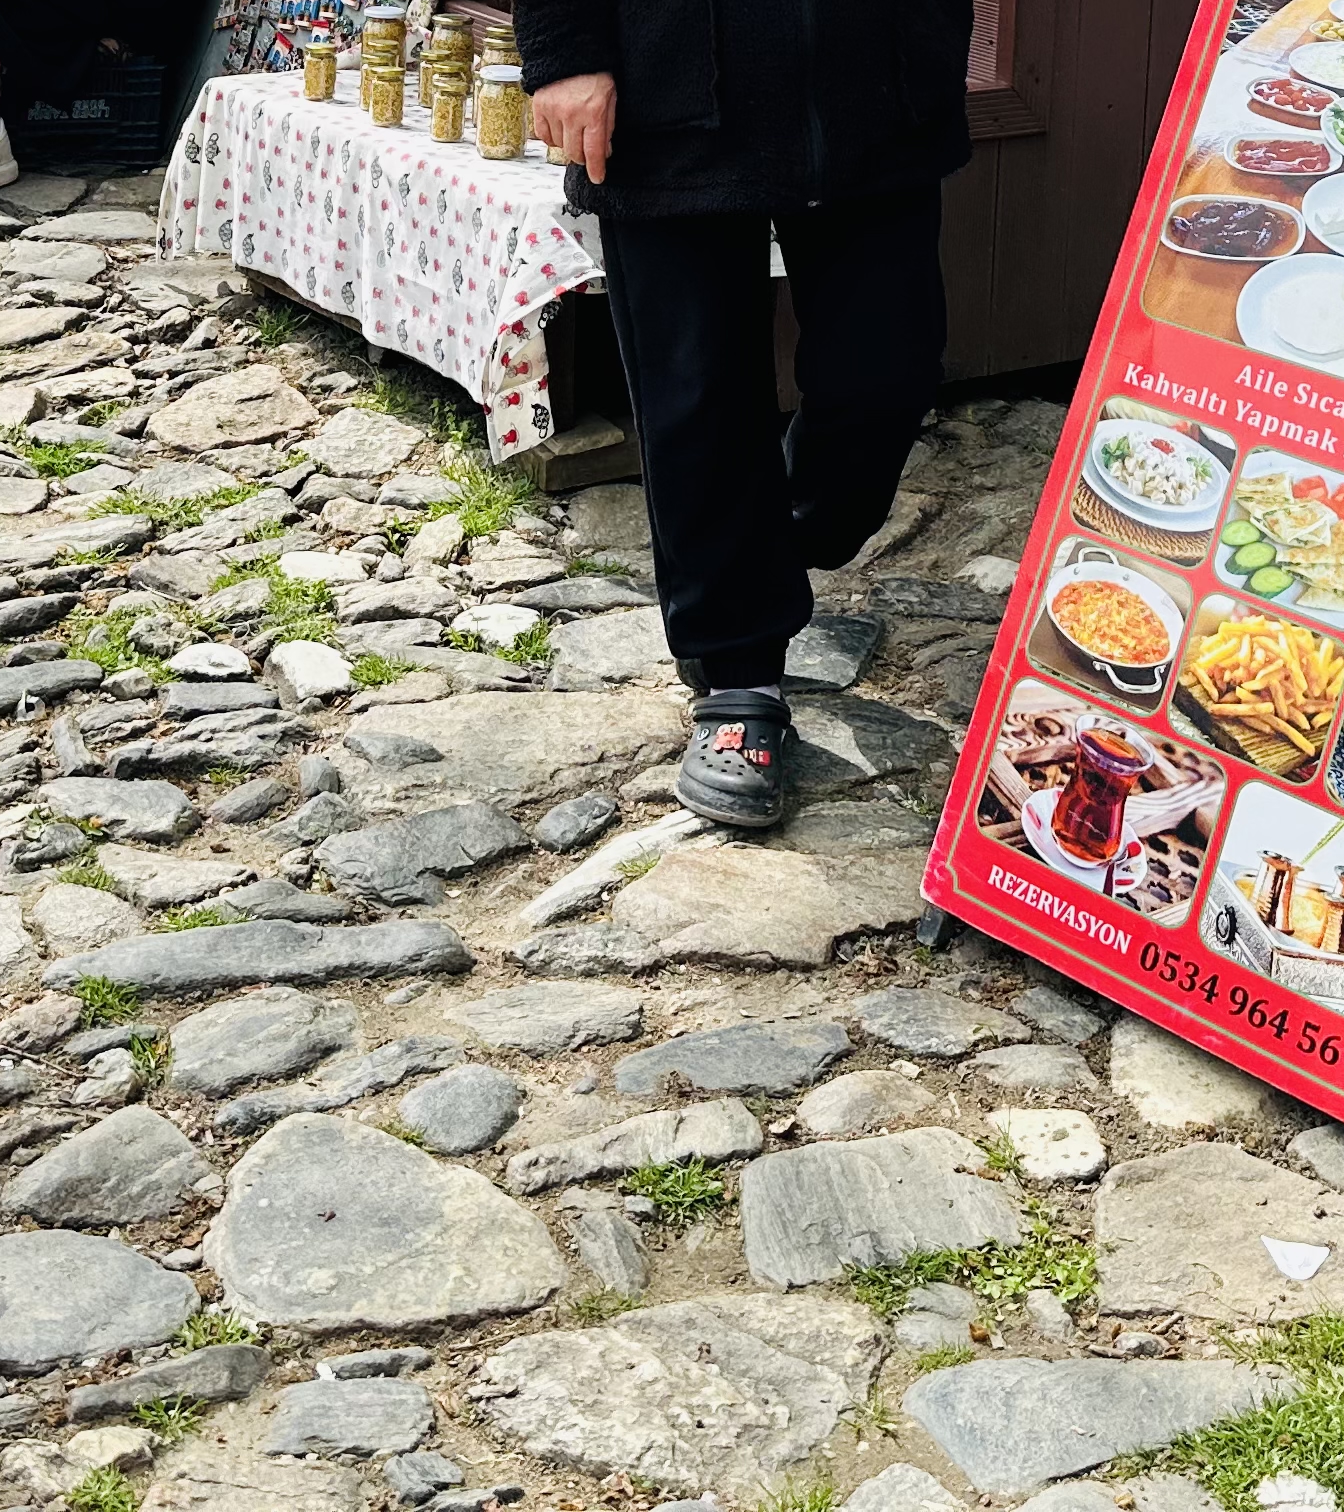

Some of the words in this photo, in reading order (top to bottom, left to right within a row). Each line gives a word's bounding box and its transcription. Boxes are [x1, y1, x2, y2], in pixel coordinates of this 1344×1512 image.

[1123, 362, 1227, 417] Kahvaltı
[1233, 402, 1337, 456] Yapmak
[1235, 364, 1289, 399] Aile
[987, 864, 1133, 956] REZERVASYON
[1139, 941, 1219, 1005] 0534
[1229, 987, 1290, 1041] 964
[1296, 1024, 1340, 1067] 56
